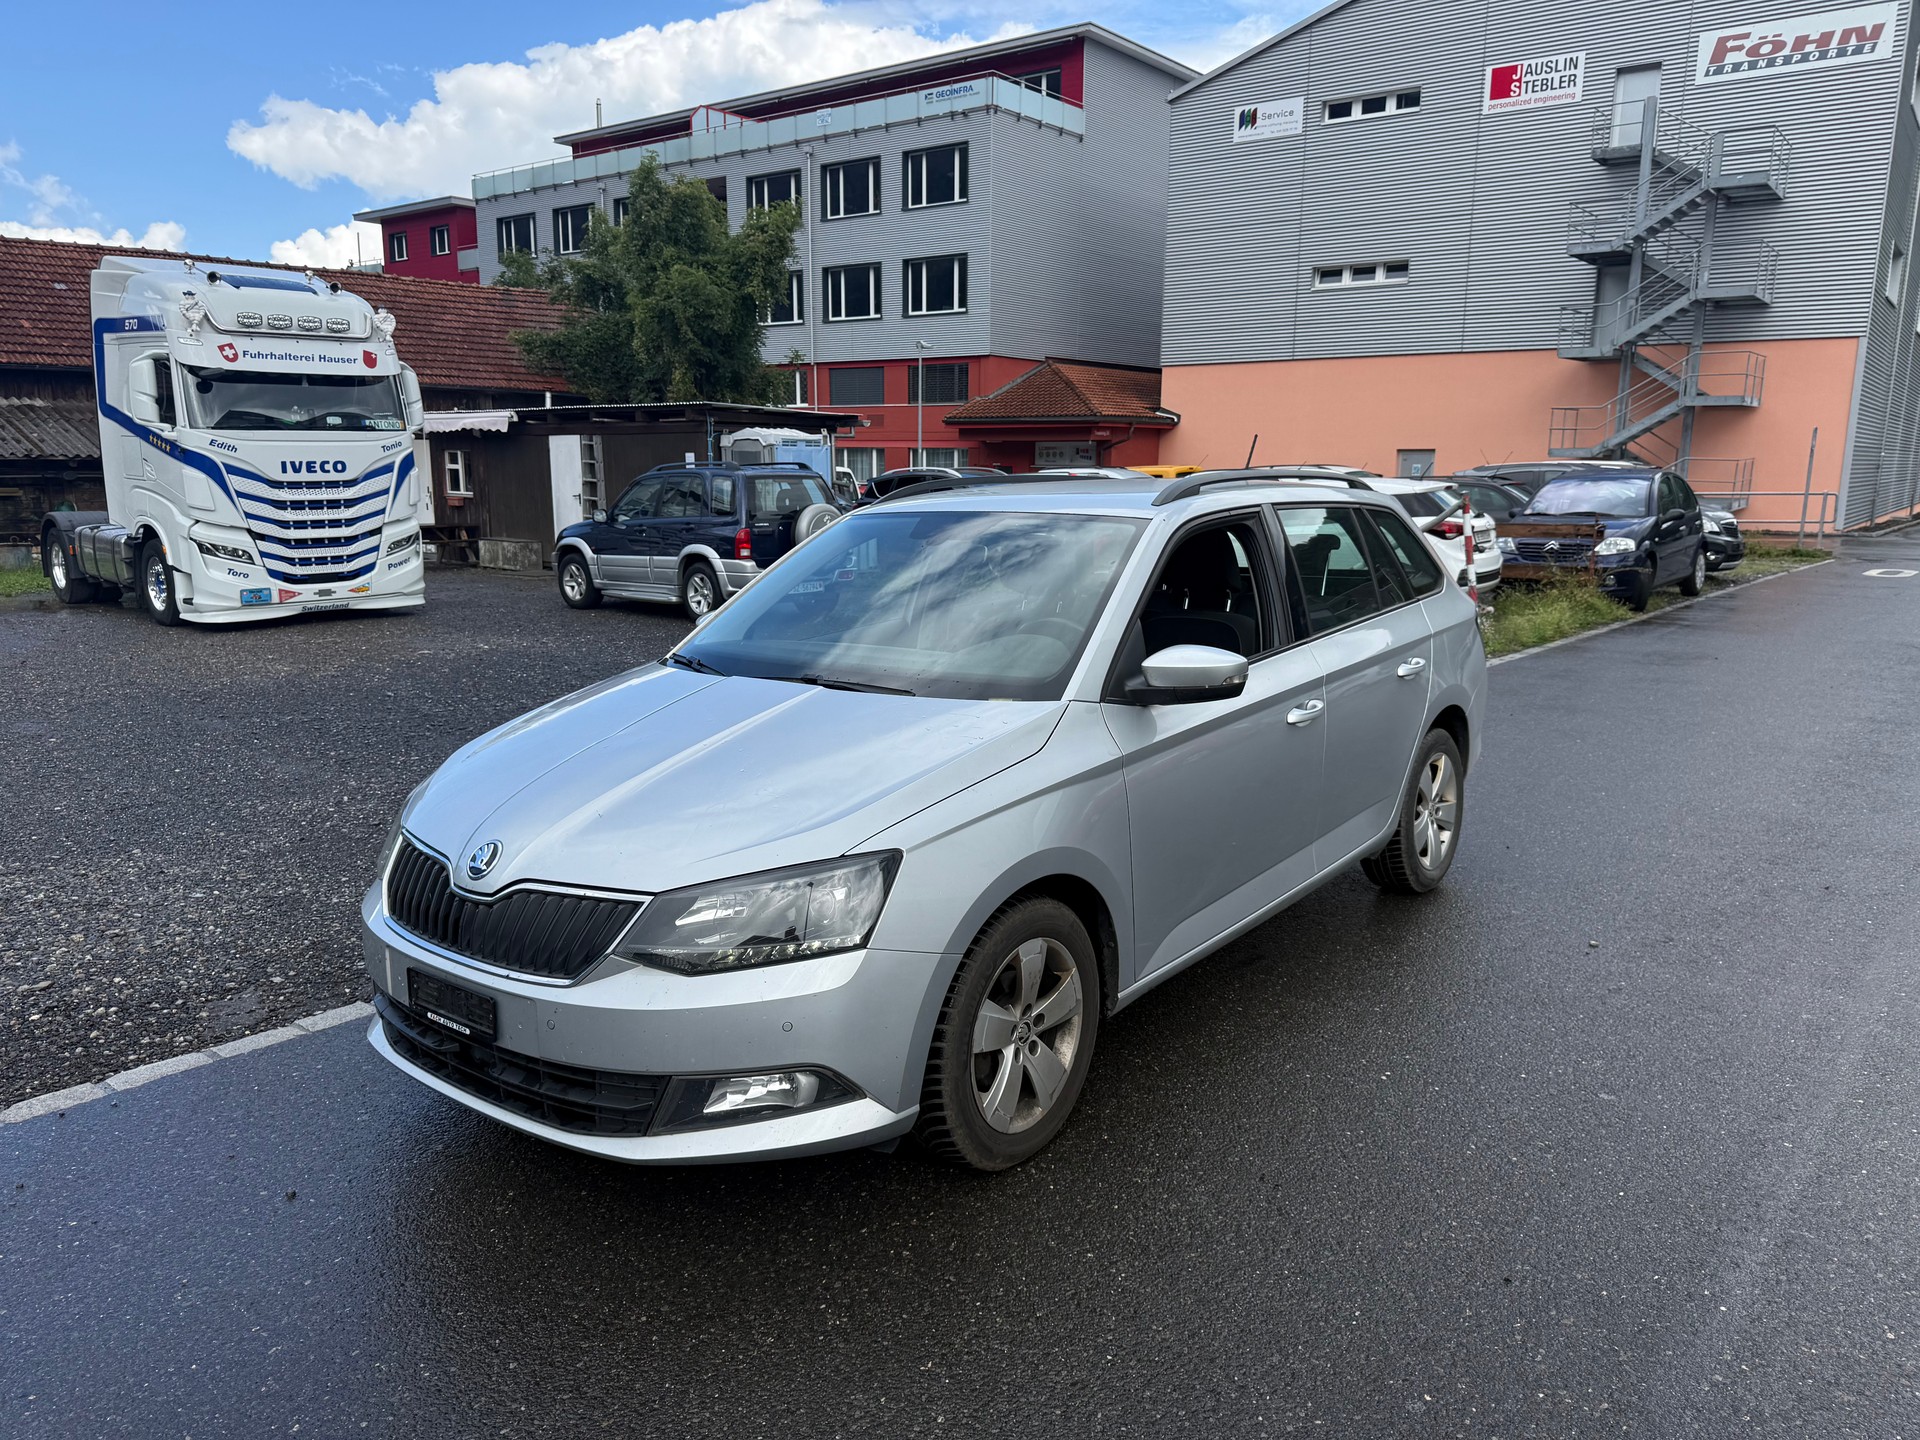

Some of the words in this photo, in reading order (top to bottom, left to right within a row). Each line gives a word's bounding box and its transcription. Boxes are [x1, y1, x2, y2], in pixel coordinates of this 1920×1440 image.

[1708, 22, 1886, 65] FÖHN
[1708, 43, 1874, 76] TRANSPORTE
[1512, 56, 1579, 80] JAUSLIN
[935, 84, 974, 99] GEOINFRA
[1510, 73, 1577, 96] STEBLER
[1488, 97, 1532, 112] personalized
[1533, 92, 1576, 104] engineering
[124, 319, 138, 330] 570
[242, 350, 315, 362] Fuhrhalterei
[318, 354, 358, 364] Hauser
[368, 420, 400, 429] ANTONIO
[208, 438, 238, 453] Edith
[381, 440, 402, 453] Tonio
[280, 460, 347, 474] IVECO
[387, 556, 412, 571] Power
[226, 567, 250, 579] Toro
[301, 602, 350, 612] Switzerland
